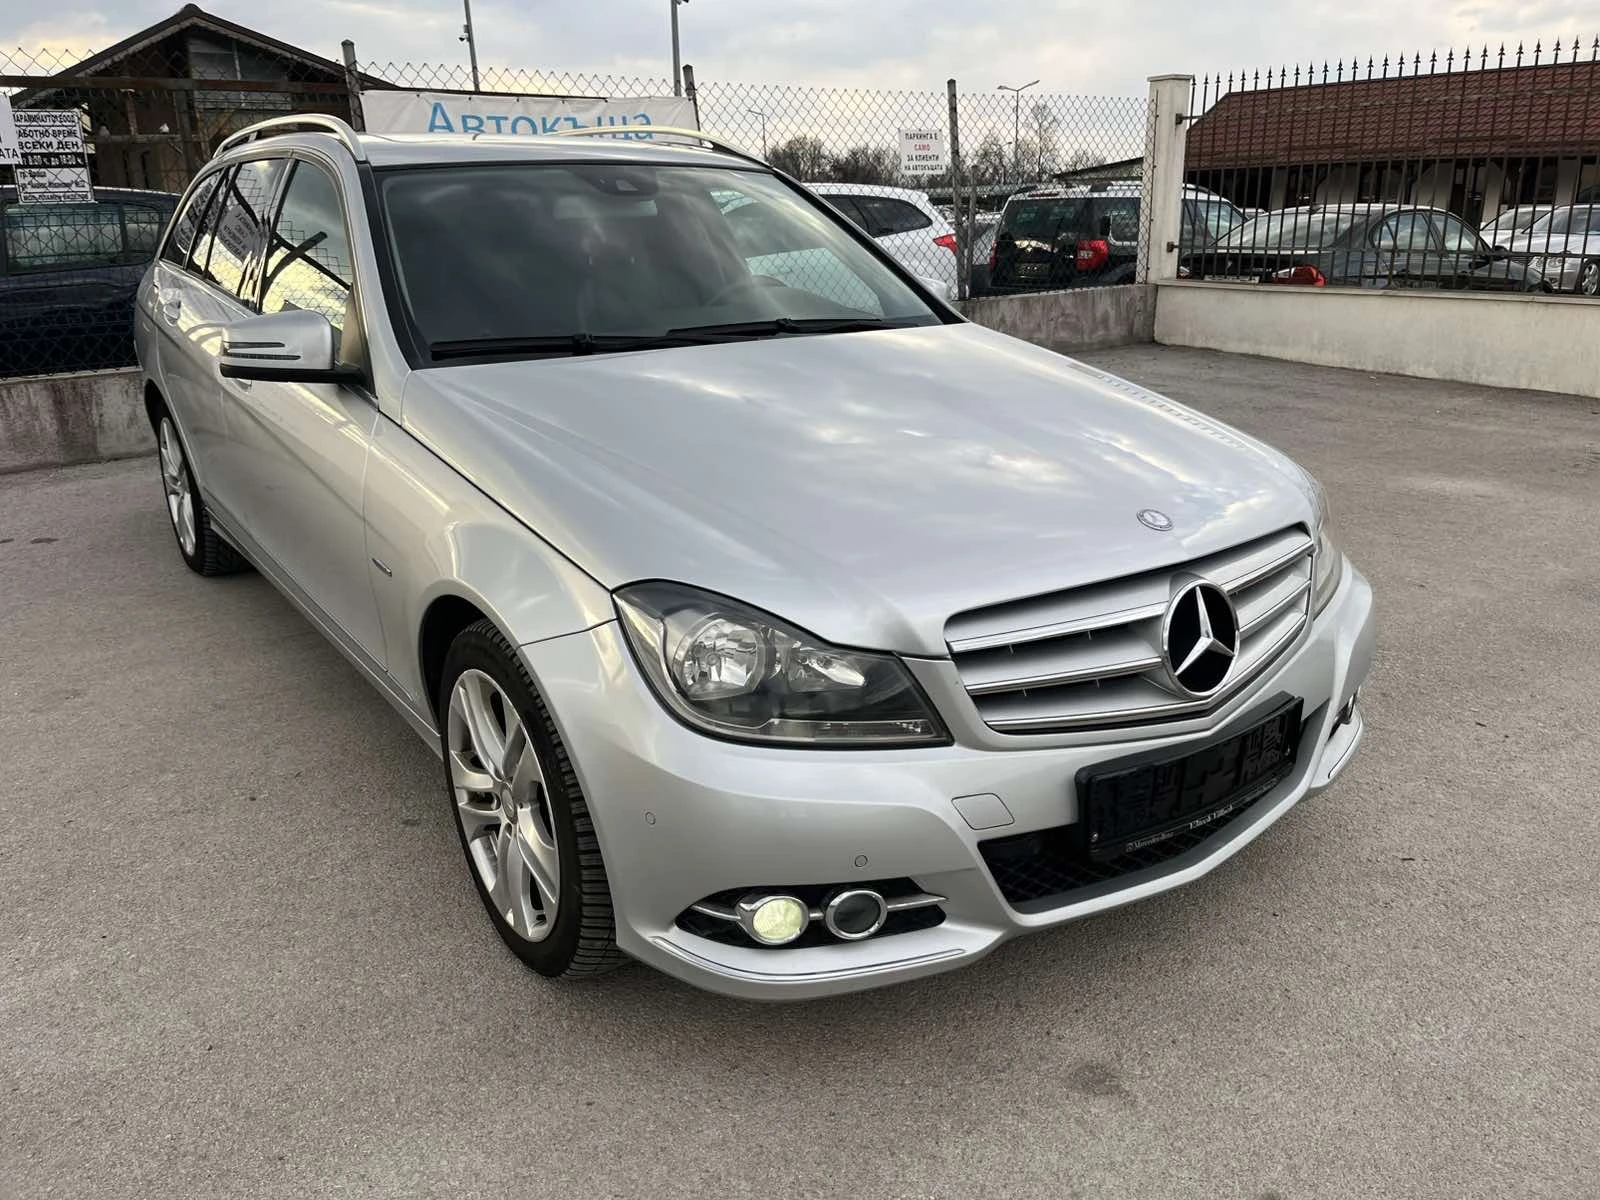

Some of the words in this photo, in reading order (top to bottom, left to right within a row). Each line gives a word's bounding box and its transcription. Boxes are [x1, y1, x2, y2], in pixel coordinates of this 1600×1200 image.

[16, 128, 50, 138] АБОТНО
[18, 141, 53, 151] ВСЕКИ
[57, 141, 79, 151] ДЕН
[914, 143, 930, 151] САМО
[907, 154, 914, 162] ЗА
[915, 154, 939, 162] КЛИЕНТИ
